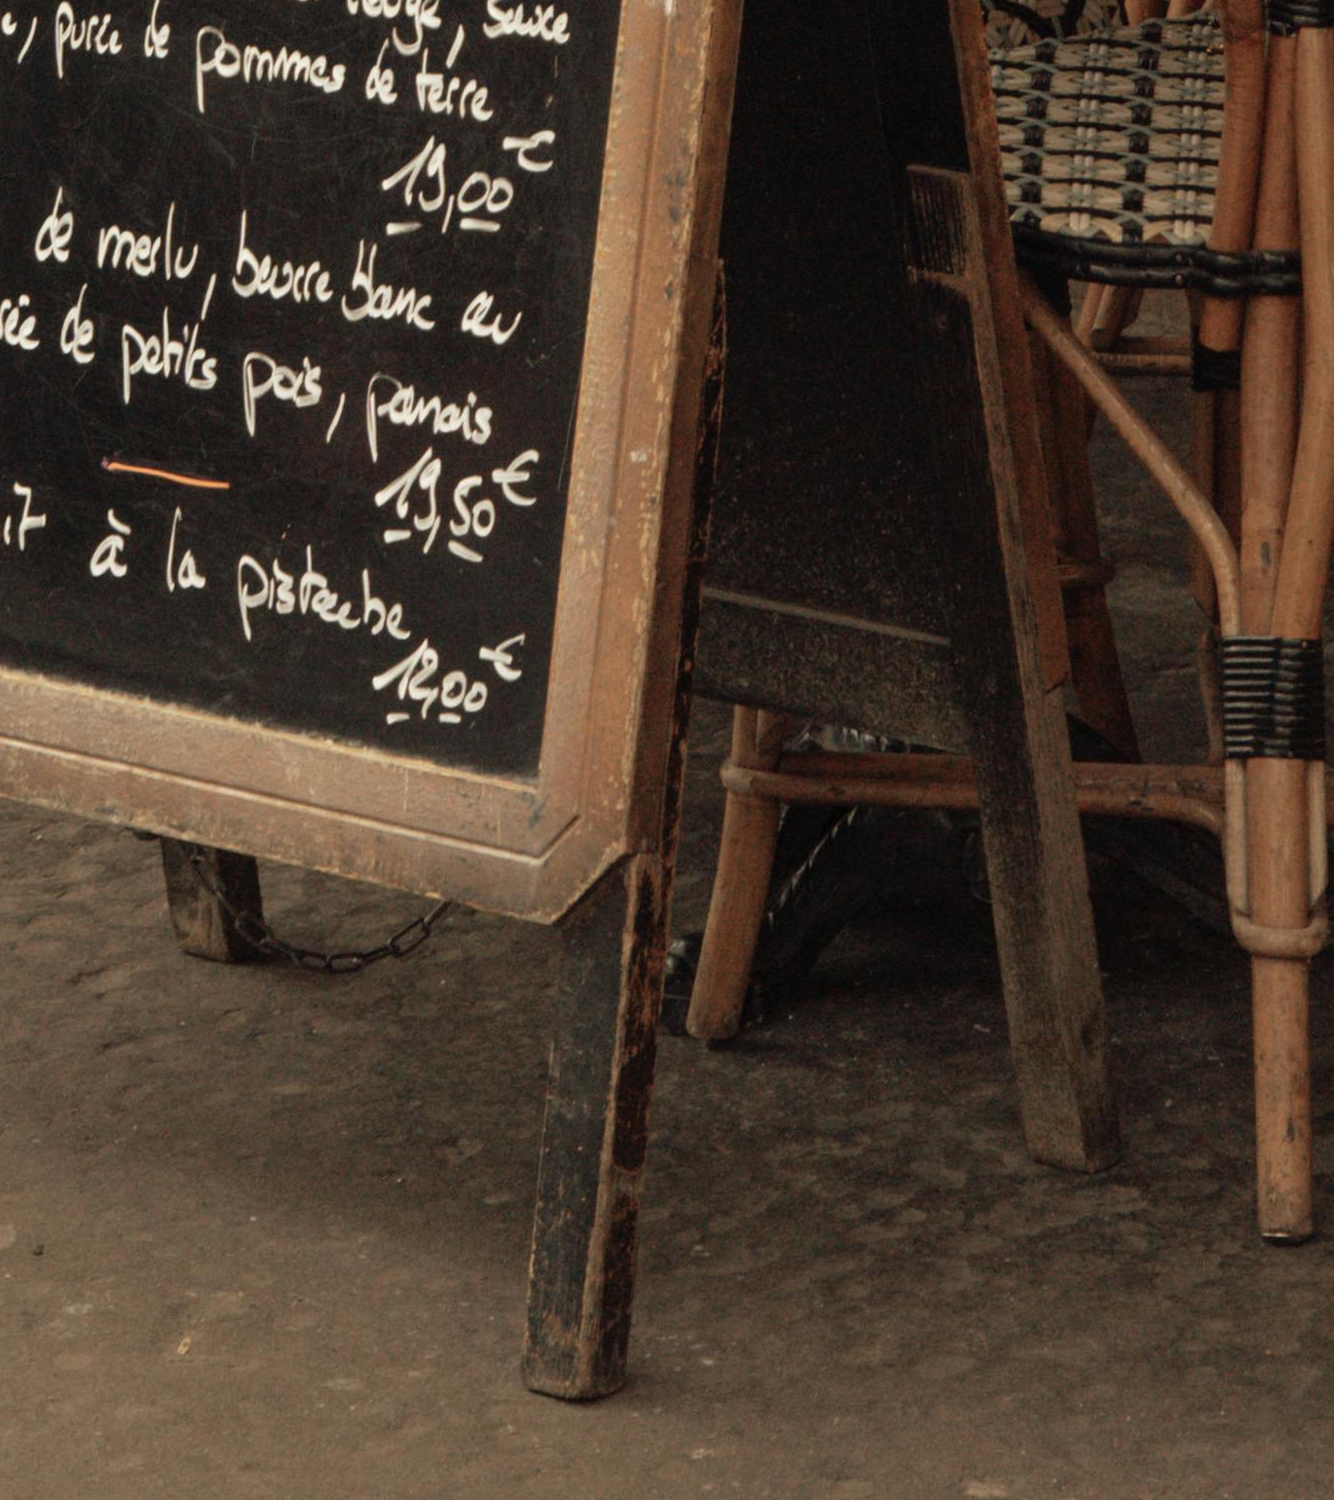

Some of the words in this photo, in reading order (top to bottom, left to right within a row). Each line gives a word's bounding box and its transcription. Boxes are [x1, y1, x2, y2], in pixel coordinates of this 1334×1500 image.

[55, 2, 123, 79] purée
[196, 25, 345, 113] pommes
[366, 40, 398, 105] de
[416, 49, 493, 122] terre
[35, 187, 73, 262] de
[233, 211, 333, 301] beurre
[343, 240, 435, 331] blanc
[461, 292, 521, 345] au
[60, 284, 96, 364] de
[123, 306, 218, 404] petits
[366, 373, 494, 462] panais
[89, 511, 128, 578] à
[166, 506, 206, 592] la
[238, 545, 411, 642] pistache
